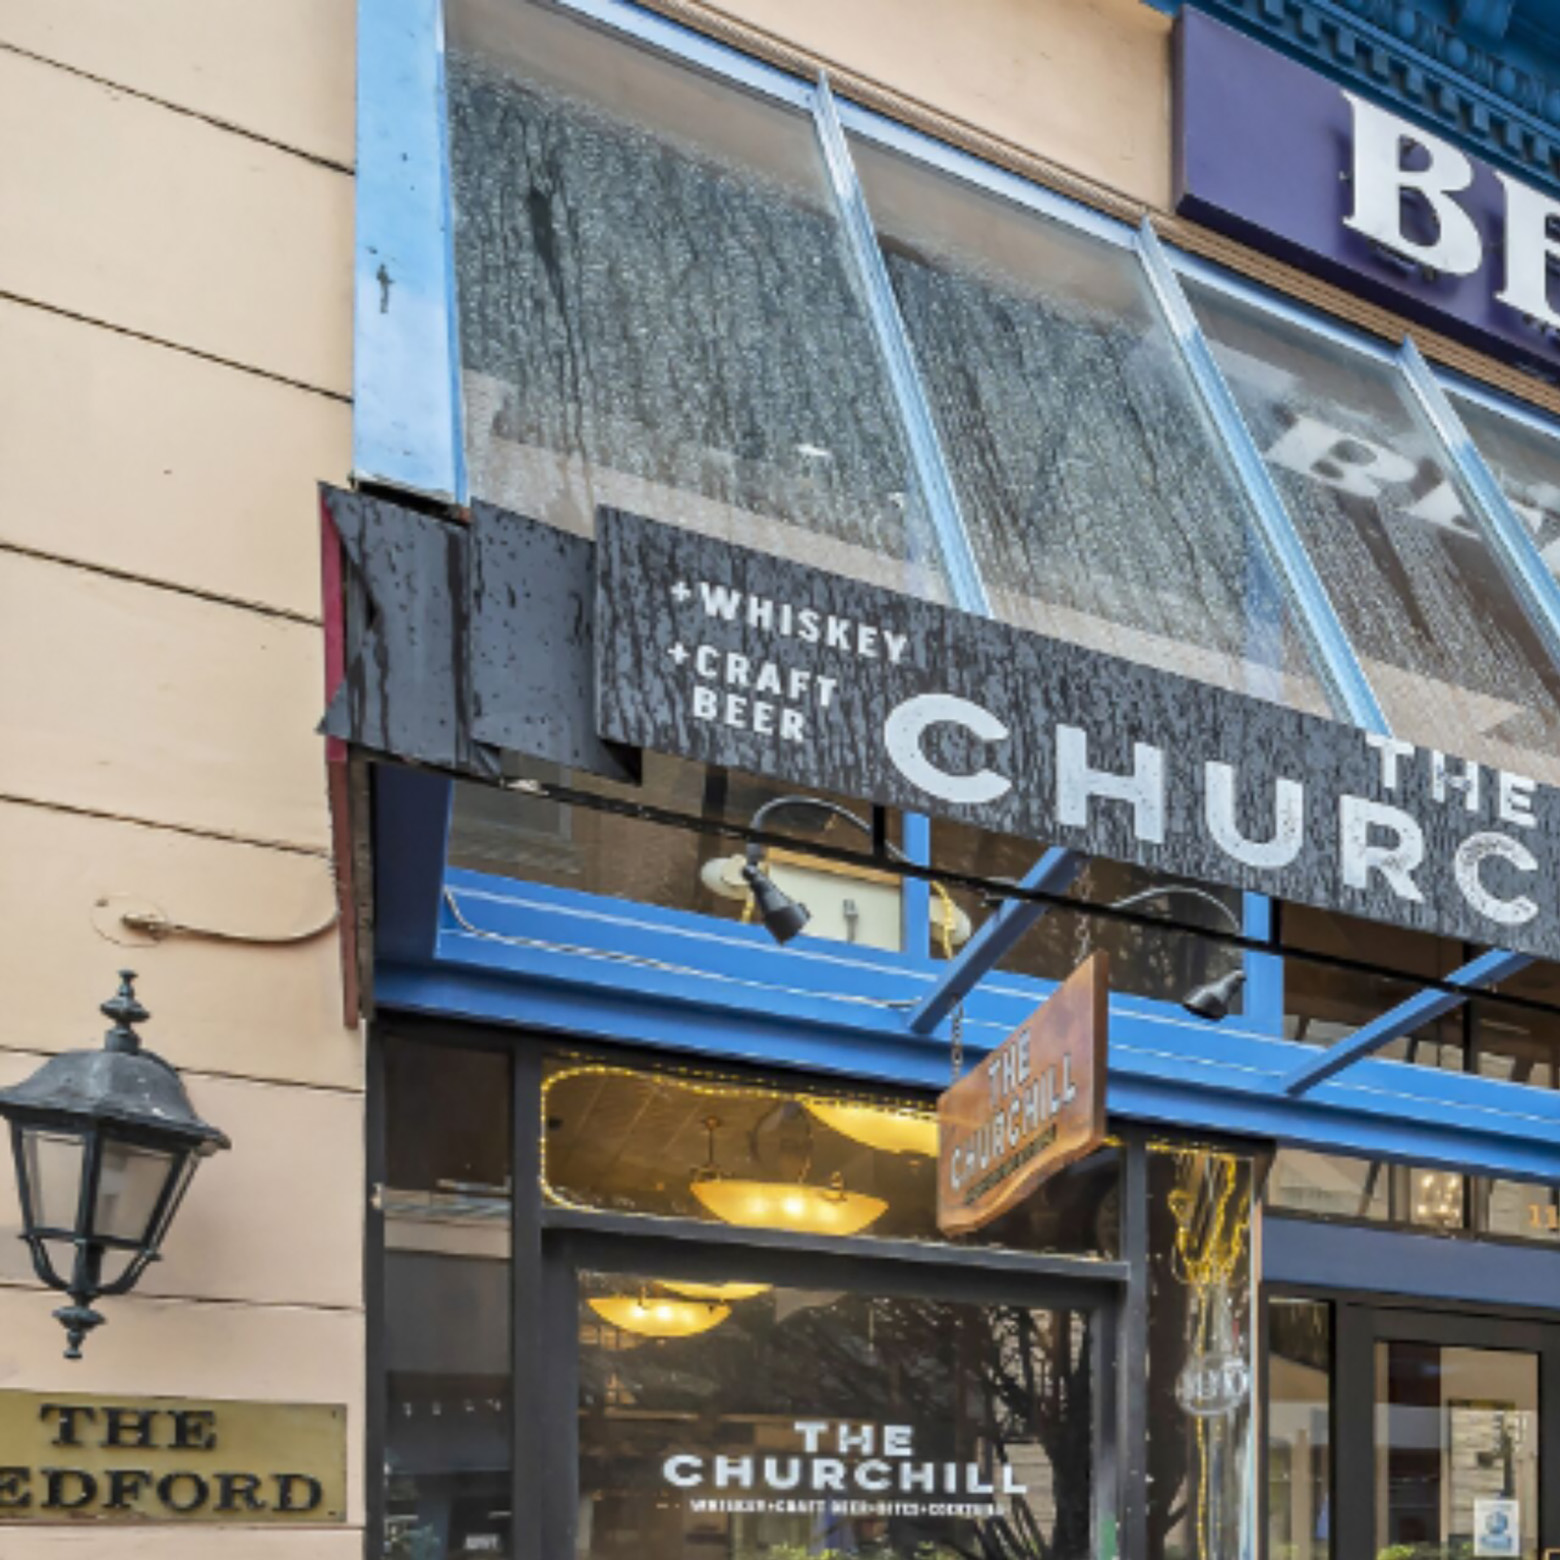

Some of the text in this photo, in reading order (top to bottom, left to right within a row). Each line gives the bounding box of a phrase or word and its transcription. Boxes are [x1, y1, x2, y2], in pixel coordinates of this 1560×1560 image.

[692, 684, 807, 742] BEER
[1363, 732, 1540, 828] THE
[988, 1028, 1032, 1108] THE
[951, 1053, 1077, 1192] CHURCHILL
[39, 1403, 218, 1452] THE
[794, 1420, 915, 1458] THE
[662, 1454, 1028, 1496] CHURCHILL
